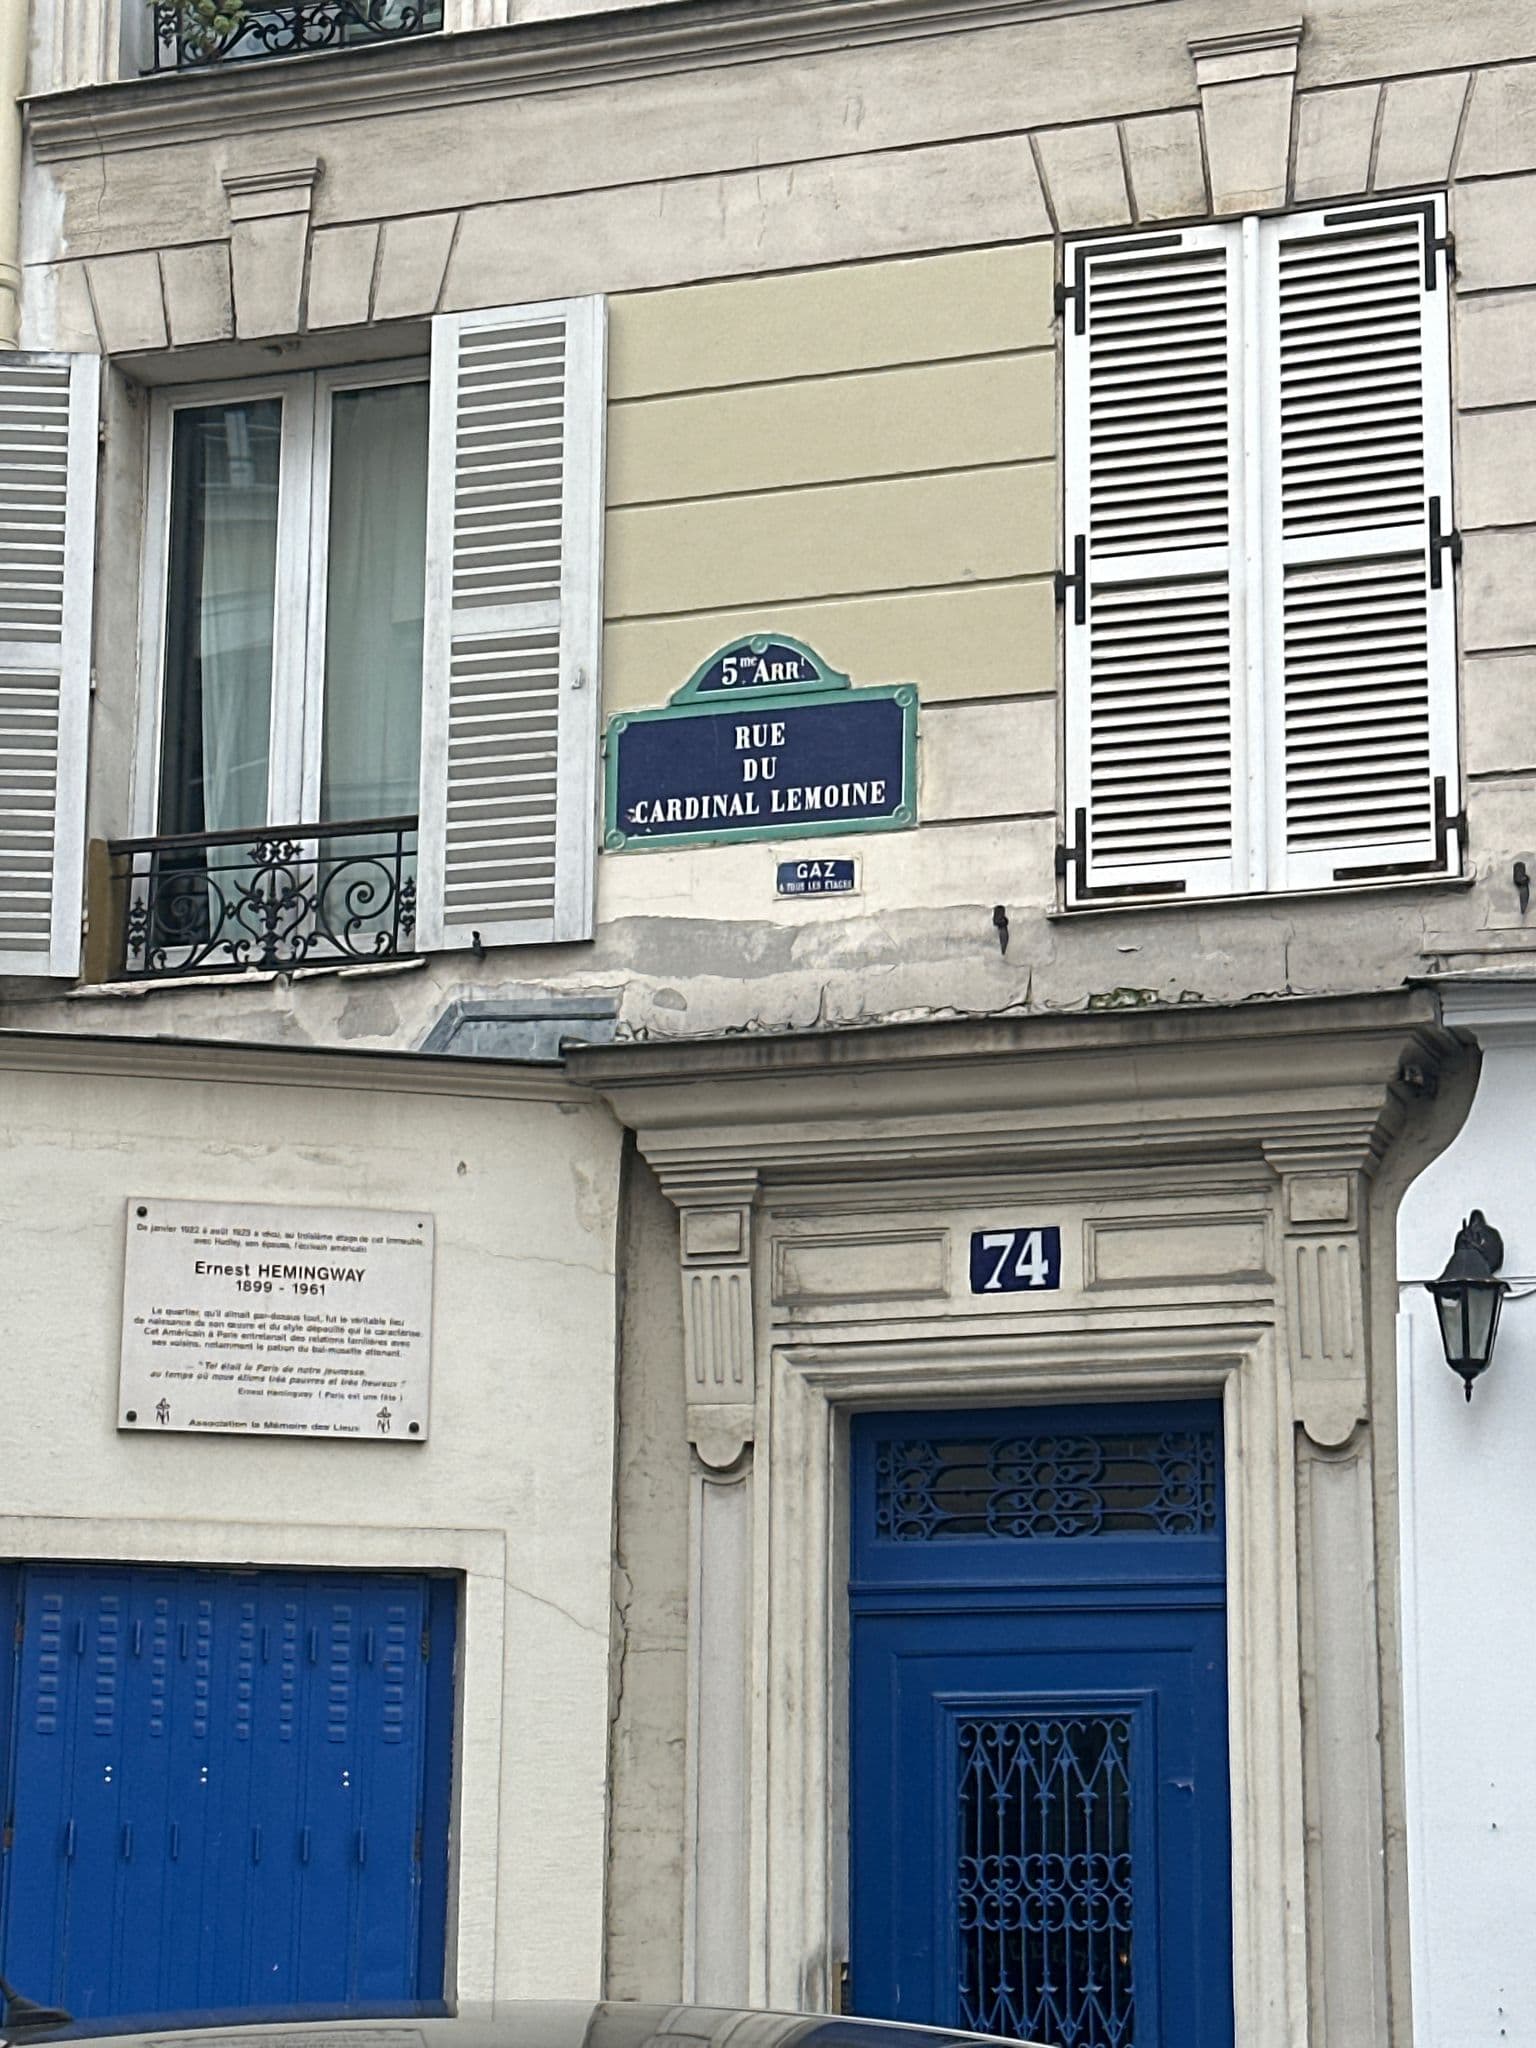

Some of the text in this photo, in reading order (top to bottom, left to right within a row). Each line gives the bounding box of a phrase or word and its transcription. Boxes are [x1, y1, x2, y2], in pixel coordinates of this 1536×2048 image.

[735, 722, 785, 750] RUE
[743, 757, 777, 782] DU
[635, 780, 886, 824] CARDINAL LEMOINE
[796, 861, 836, 879] GAZ
[150, 1224, 176, 1234] janvier
[195, 1260, 366, 1283] Ernest HEMINGWAY
[982, 1231, 1049, 1289] 74
[236, 1280, 272, 1292] 1899
[292, 1283, 325, 1296] 1961
